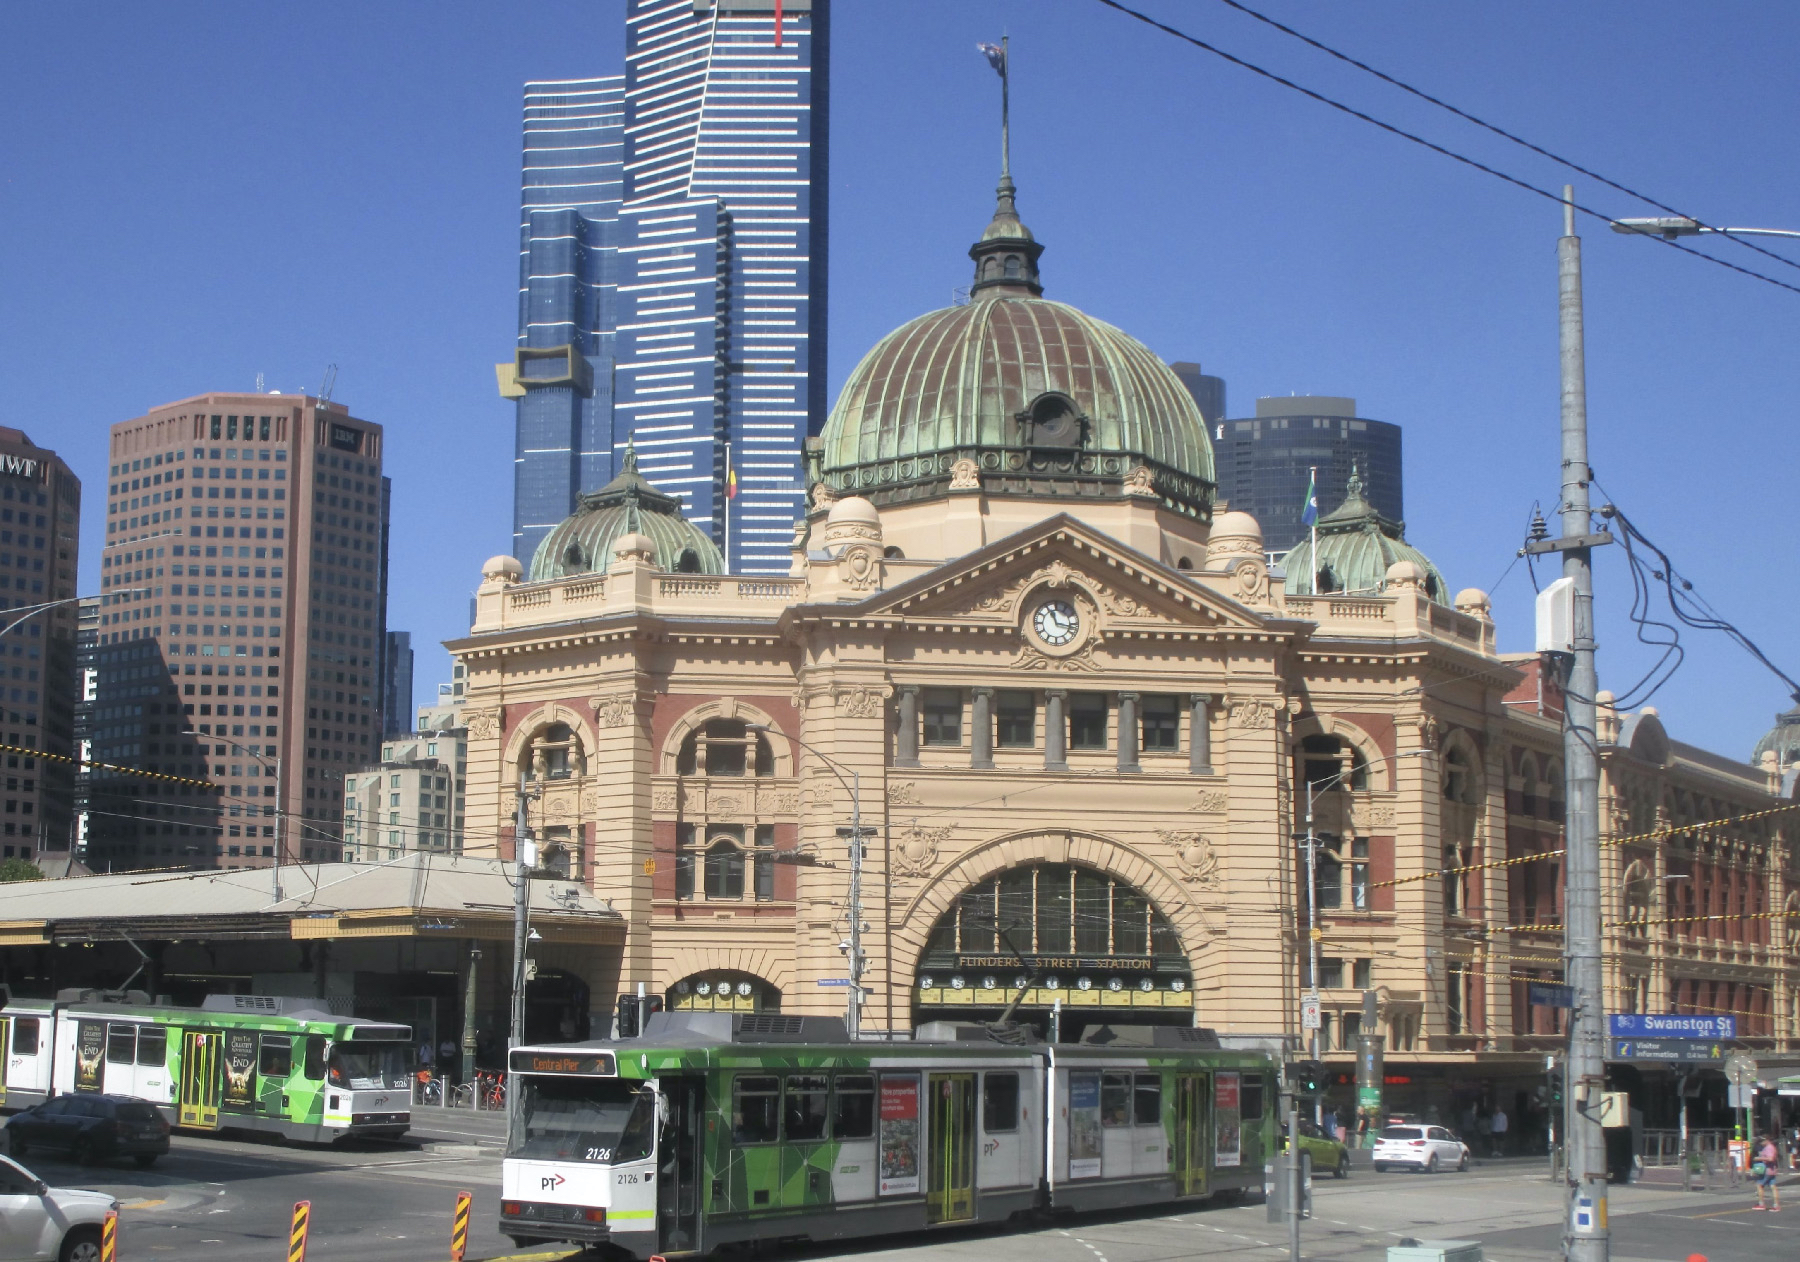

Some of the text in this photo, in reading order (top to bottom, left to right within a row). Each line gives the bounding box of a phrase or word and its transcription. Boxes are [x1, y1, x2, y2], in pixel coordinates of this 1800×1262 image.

[959, 957, 1151, 970] FLINDERS STREET STATION
[1644, 1016, 1731, 1030] Swanston St
[533, 1058, 563, 1071] Central
[563, 1058, 579, 1072] Pier
[585, 1148, 611, 1160] 2126
[617, 1174, 638, 1185] 2126
